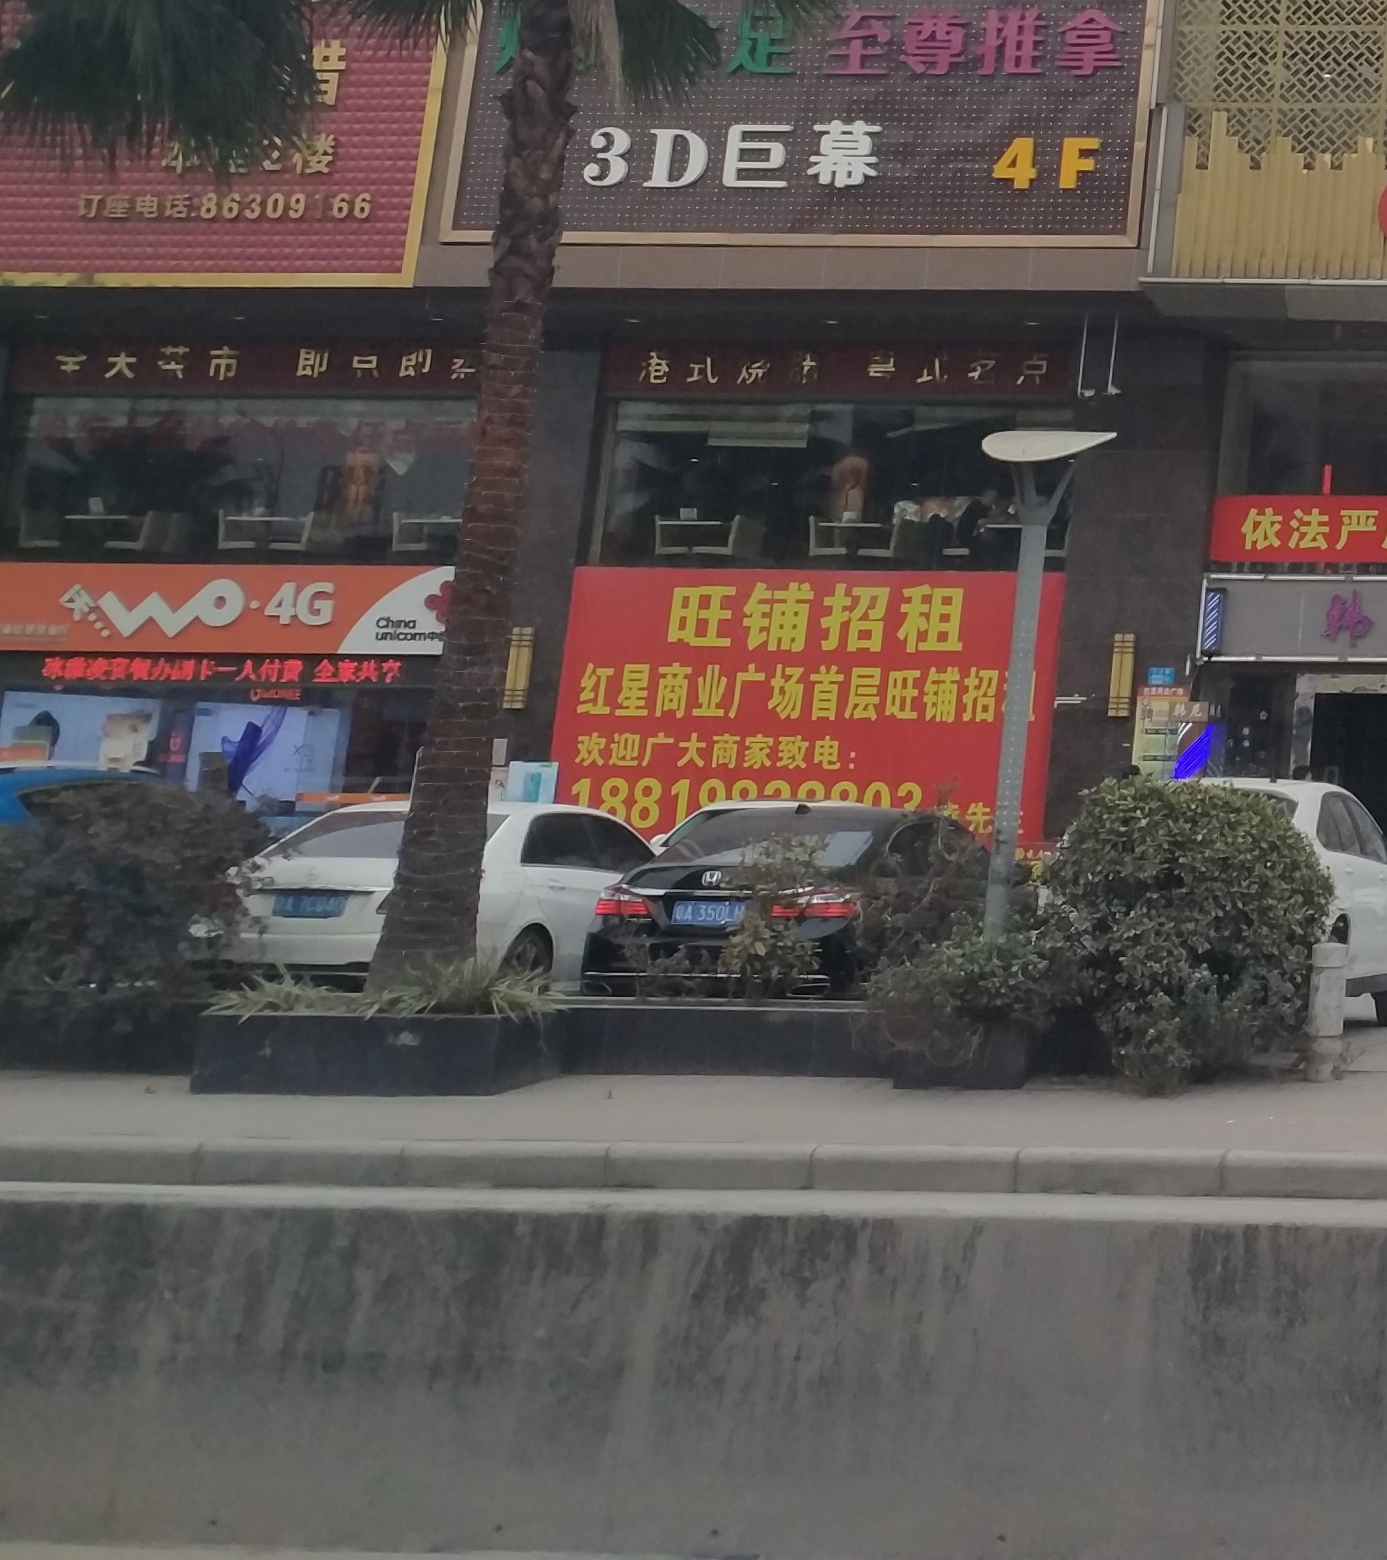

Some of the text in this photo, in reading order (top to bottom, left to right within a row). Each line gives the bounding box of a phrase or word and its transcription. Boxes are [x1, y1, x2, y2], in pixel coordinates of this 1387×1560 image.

[823, 6, 1124, 75] 至尊推拿
[583, 121, 1100, 189] 3D巨幕 4F
[667, 582, 965, 653] 旺铺招租
[576, 663, 1036, 724] 红星商业广场首层旺铺招
[576, 734, 858, 769] 欢迎广大商家致电:
